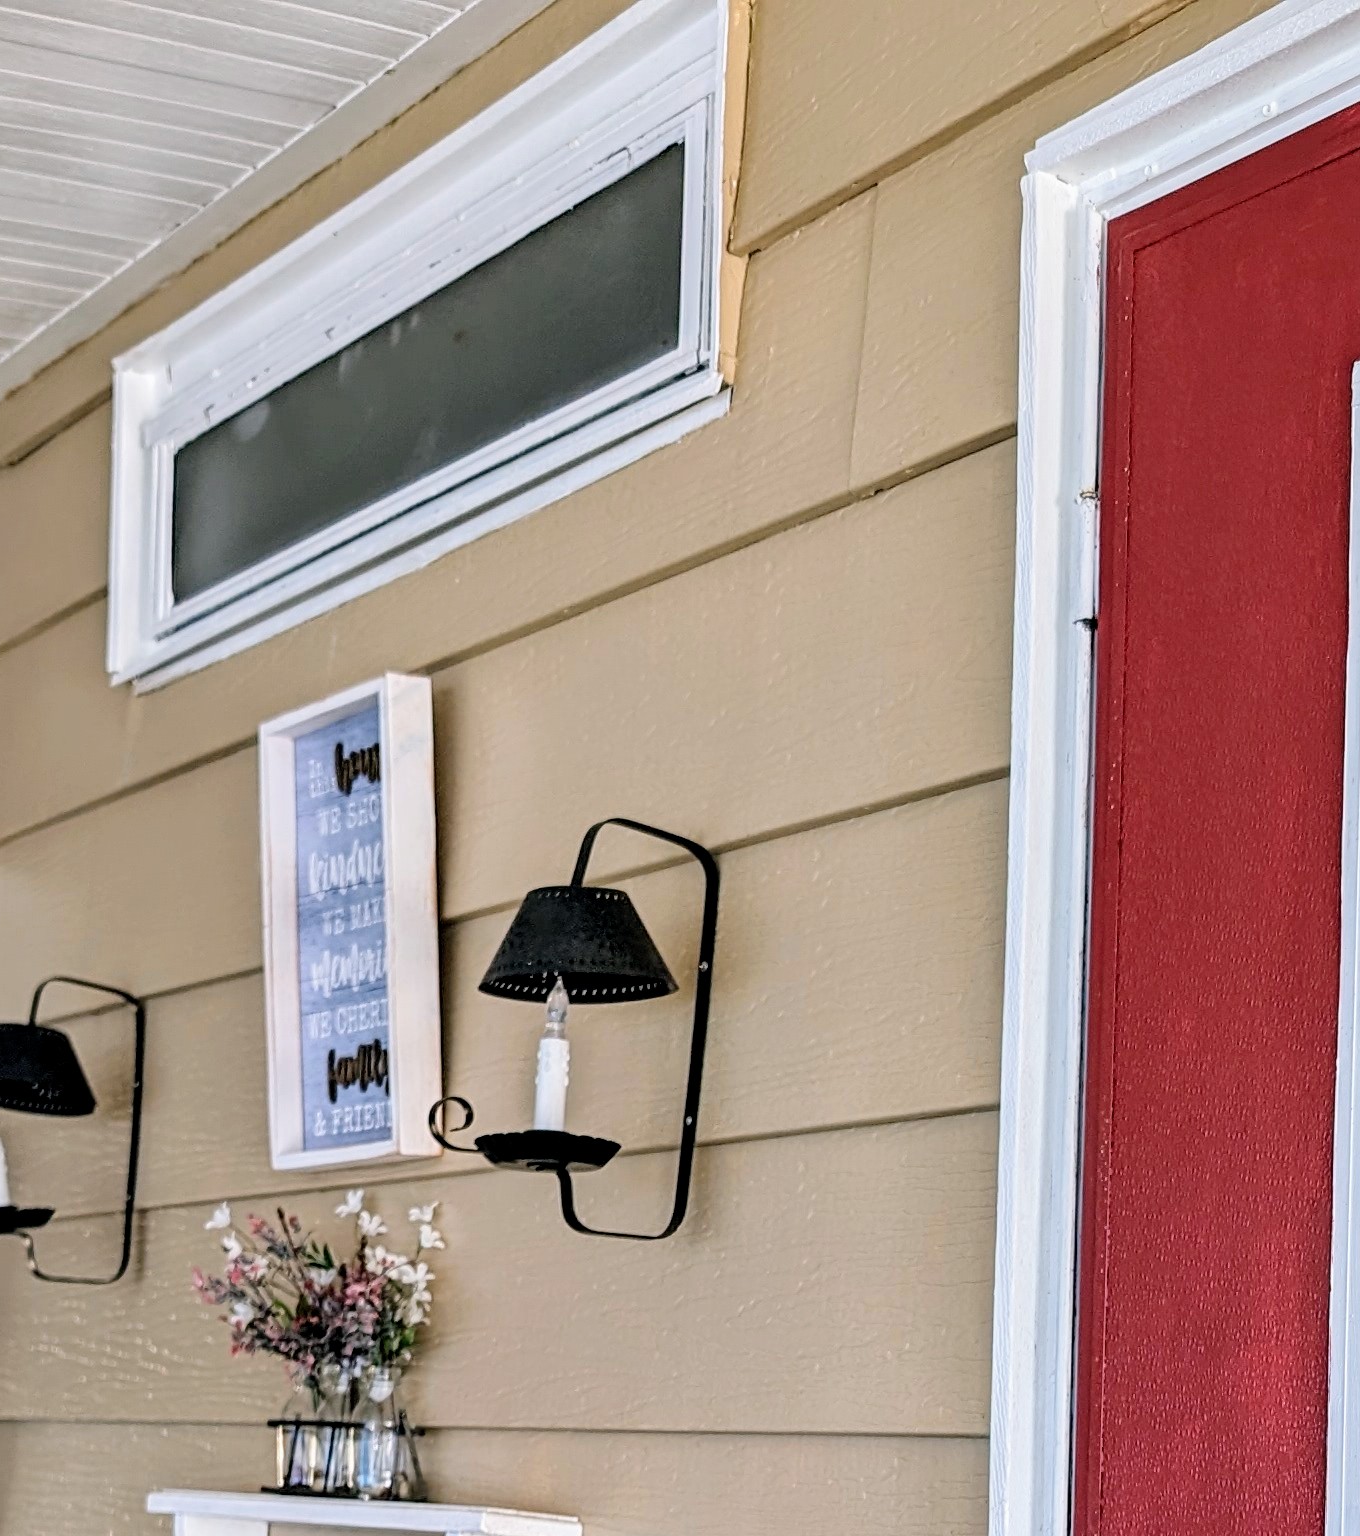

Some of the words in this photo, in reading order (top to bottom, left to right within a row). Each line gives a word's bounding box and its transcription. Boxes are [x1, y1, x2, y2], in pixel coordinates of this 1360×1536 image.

[335, 742, 380, 797] hom
[320, 807, 341, 835] WE
[347, 794, 380, 828] SHO
[308, 838, 385, 901] kindne
[322, 908, 344, 935] WE
[350, 898, 385, 930] MAK
[310, 940, 385, 998] memori
[309, 1011, 331, 1038] WE
[337, 999, 388, 1034] CHERI
[314, 1109, 327, 1136] &
[331, 1101, 391, 1134] FRIEN
